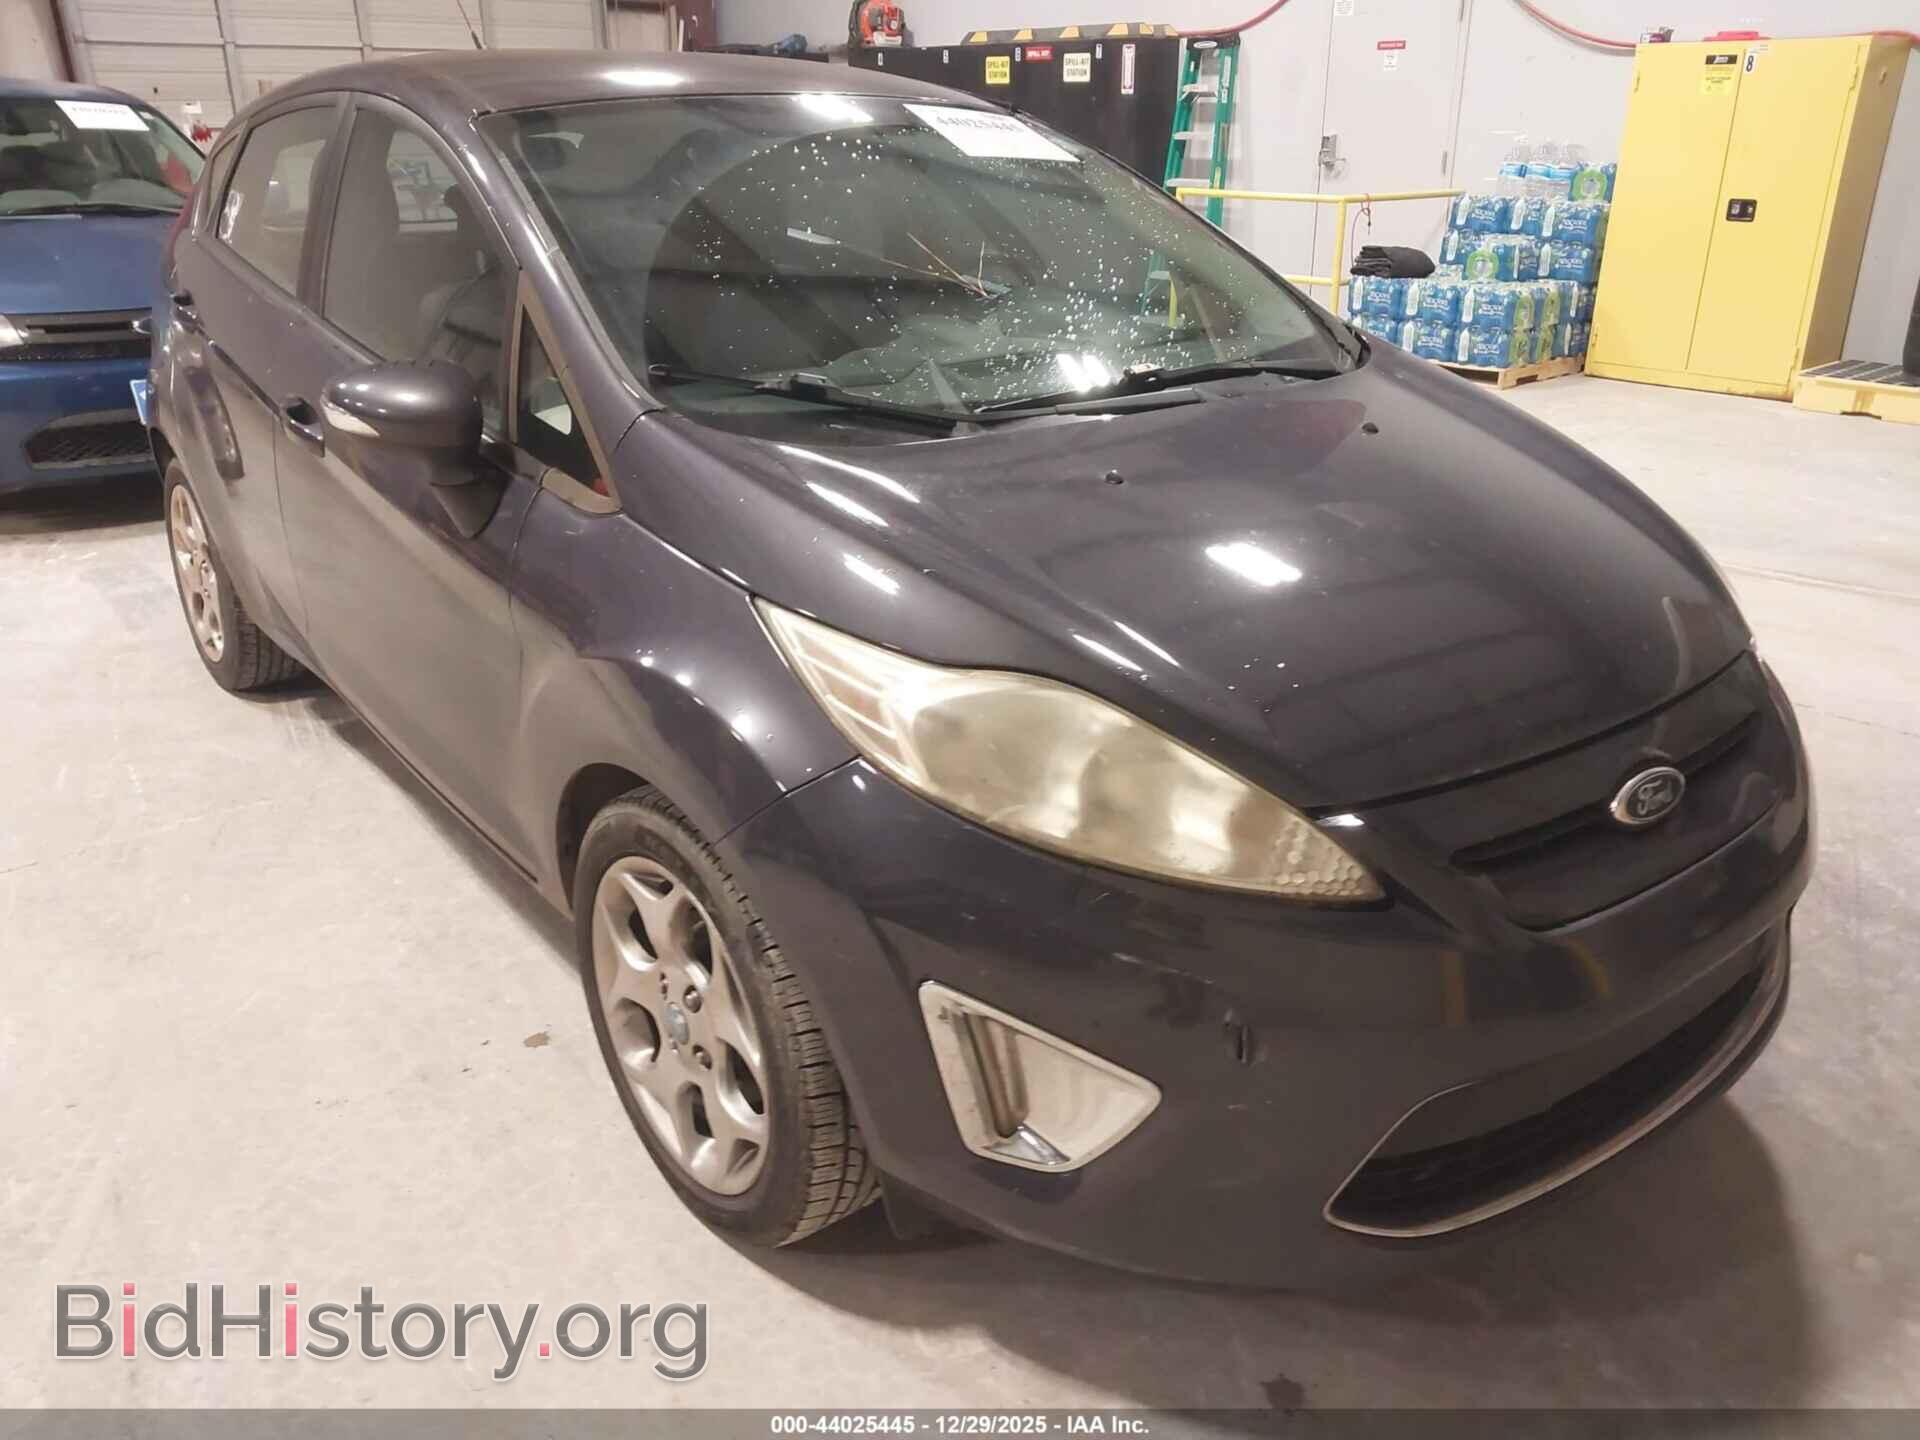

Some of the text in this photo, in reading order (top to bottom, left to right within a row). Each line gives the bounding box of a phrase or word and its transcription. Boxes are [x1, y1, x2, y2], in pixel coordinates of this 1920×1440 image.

[1746, 55, 1754, 72] 8
[988, 71, 1008, 79] STATION
[1066, 68, 1088, 77] STATION
